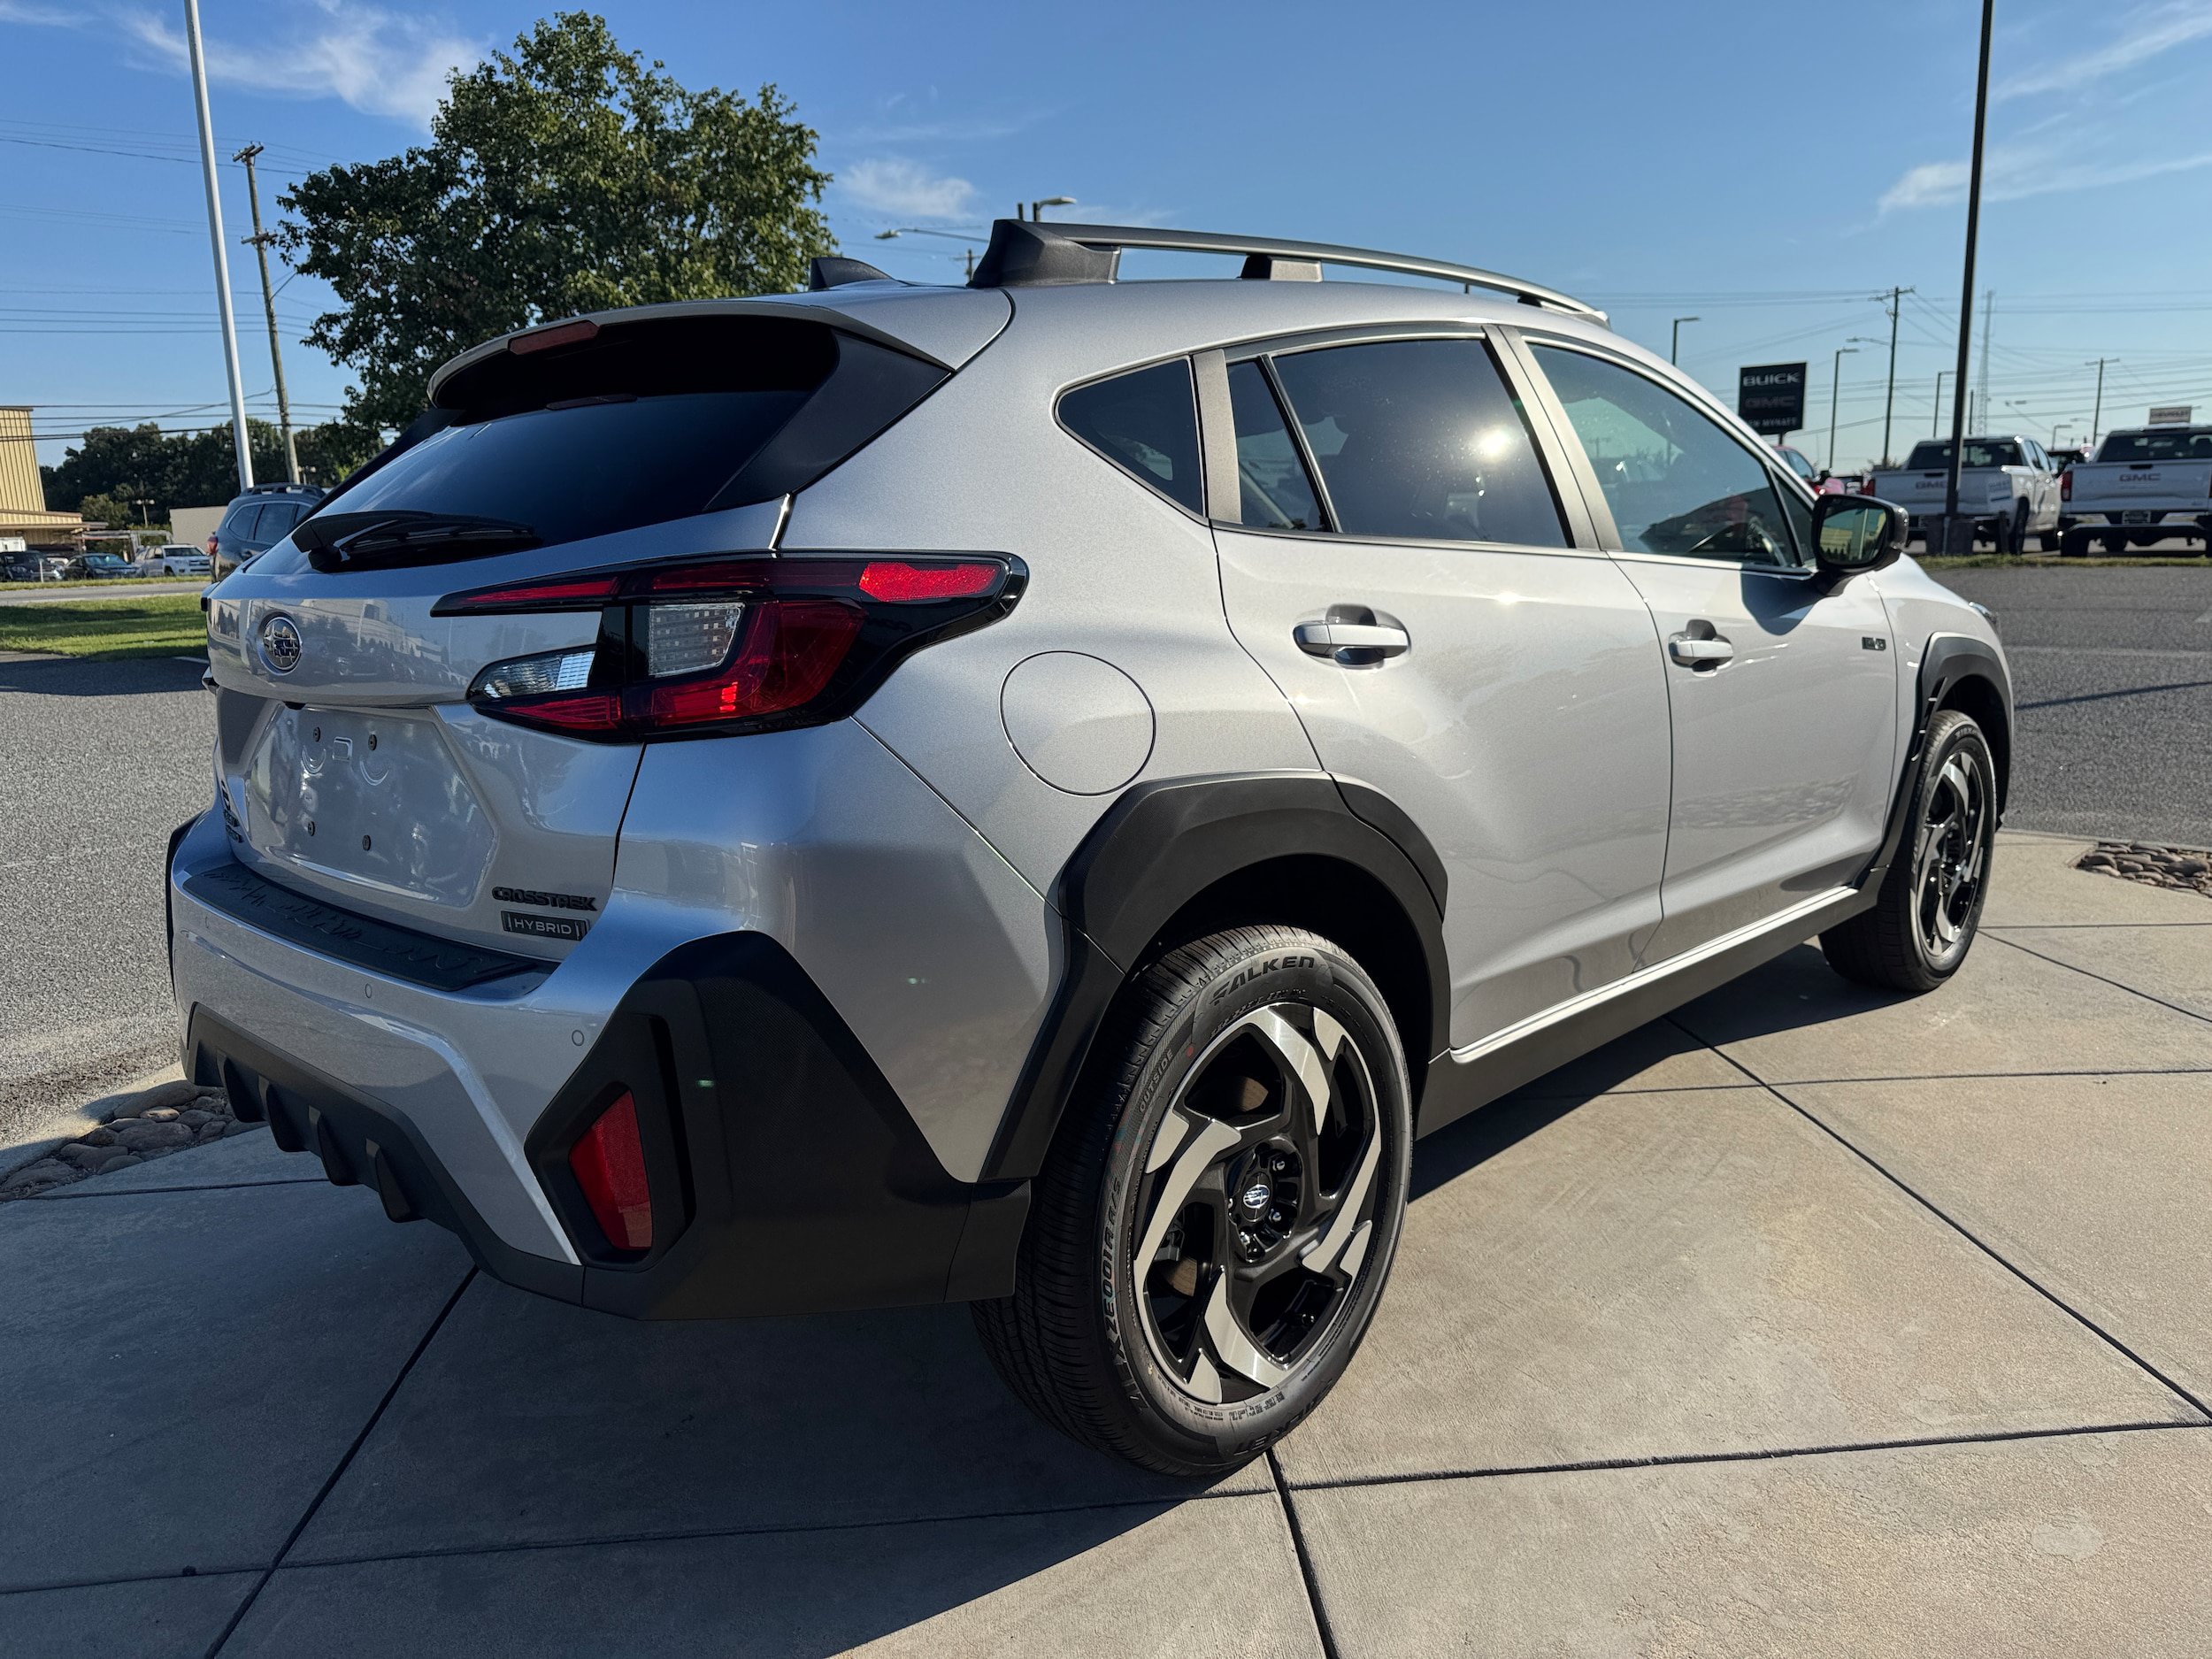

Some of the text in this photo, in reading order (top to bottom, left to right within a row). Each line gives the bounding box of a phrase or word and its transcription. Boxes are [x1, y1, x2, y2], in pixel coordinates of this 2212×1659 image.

[1743, 372, 1801, 387] BUICK
[1745, 395, 1796, 409] GMC
[2119, 472, 2162, 482] GMC
[492, 887, 597, 911] CROSSTREK
[515, 919, 572, 935] HYBRID
[1210, 956, 1315, 1006] FALKEN
[1139, 1048, 1173, 1113] OUTSIDE
